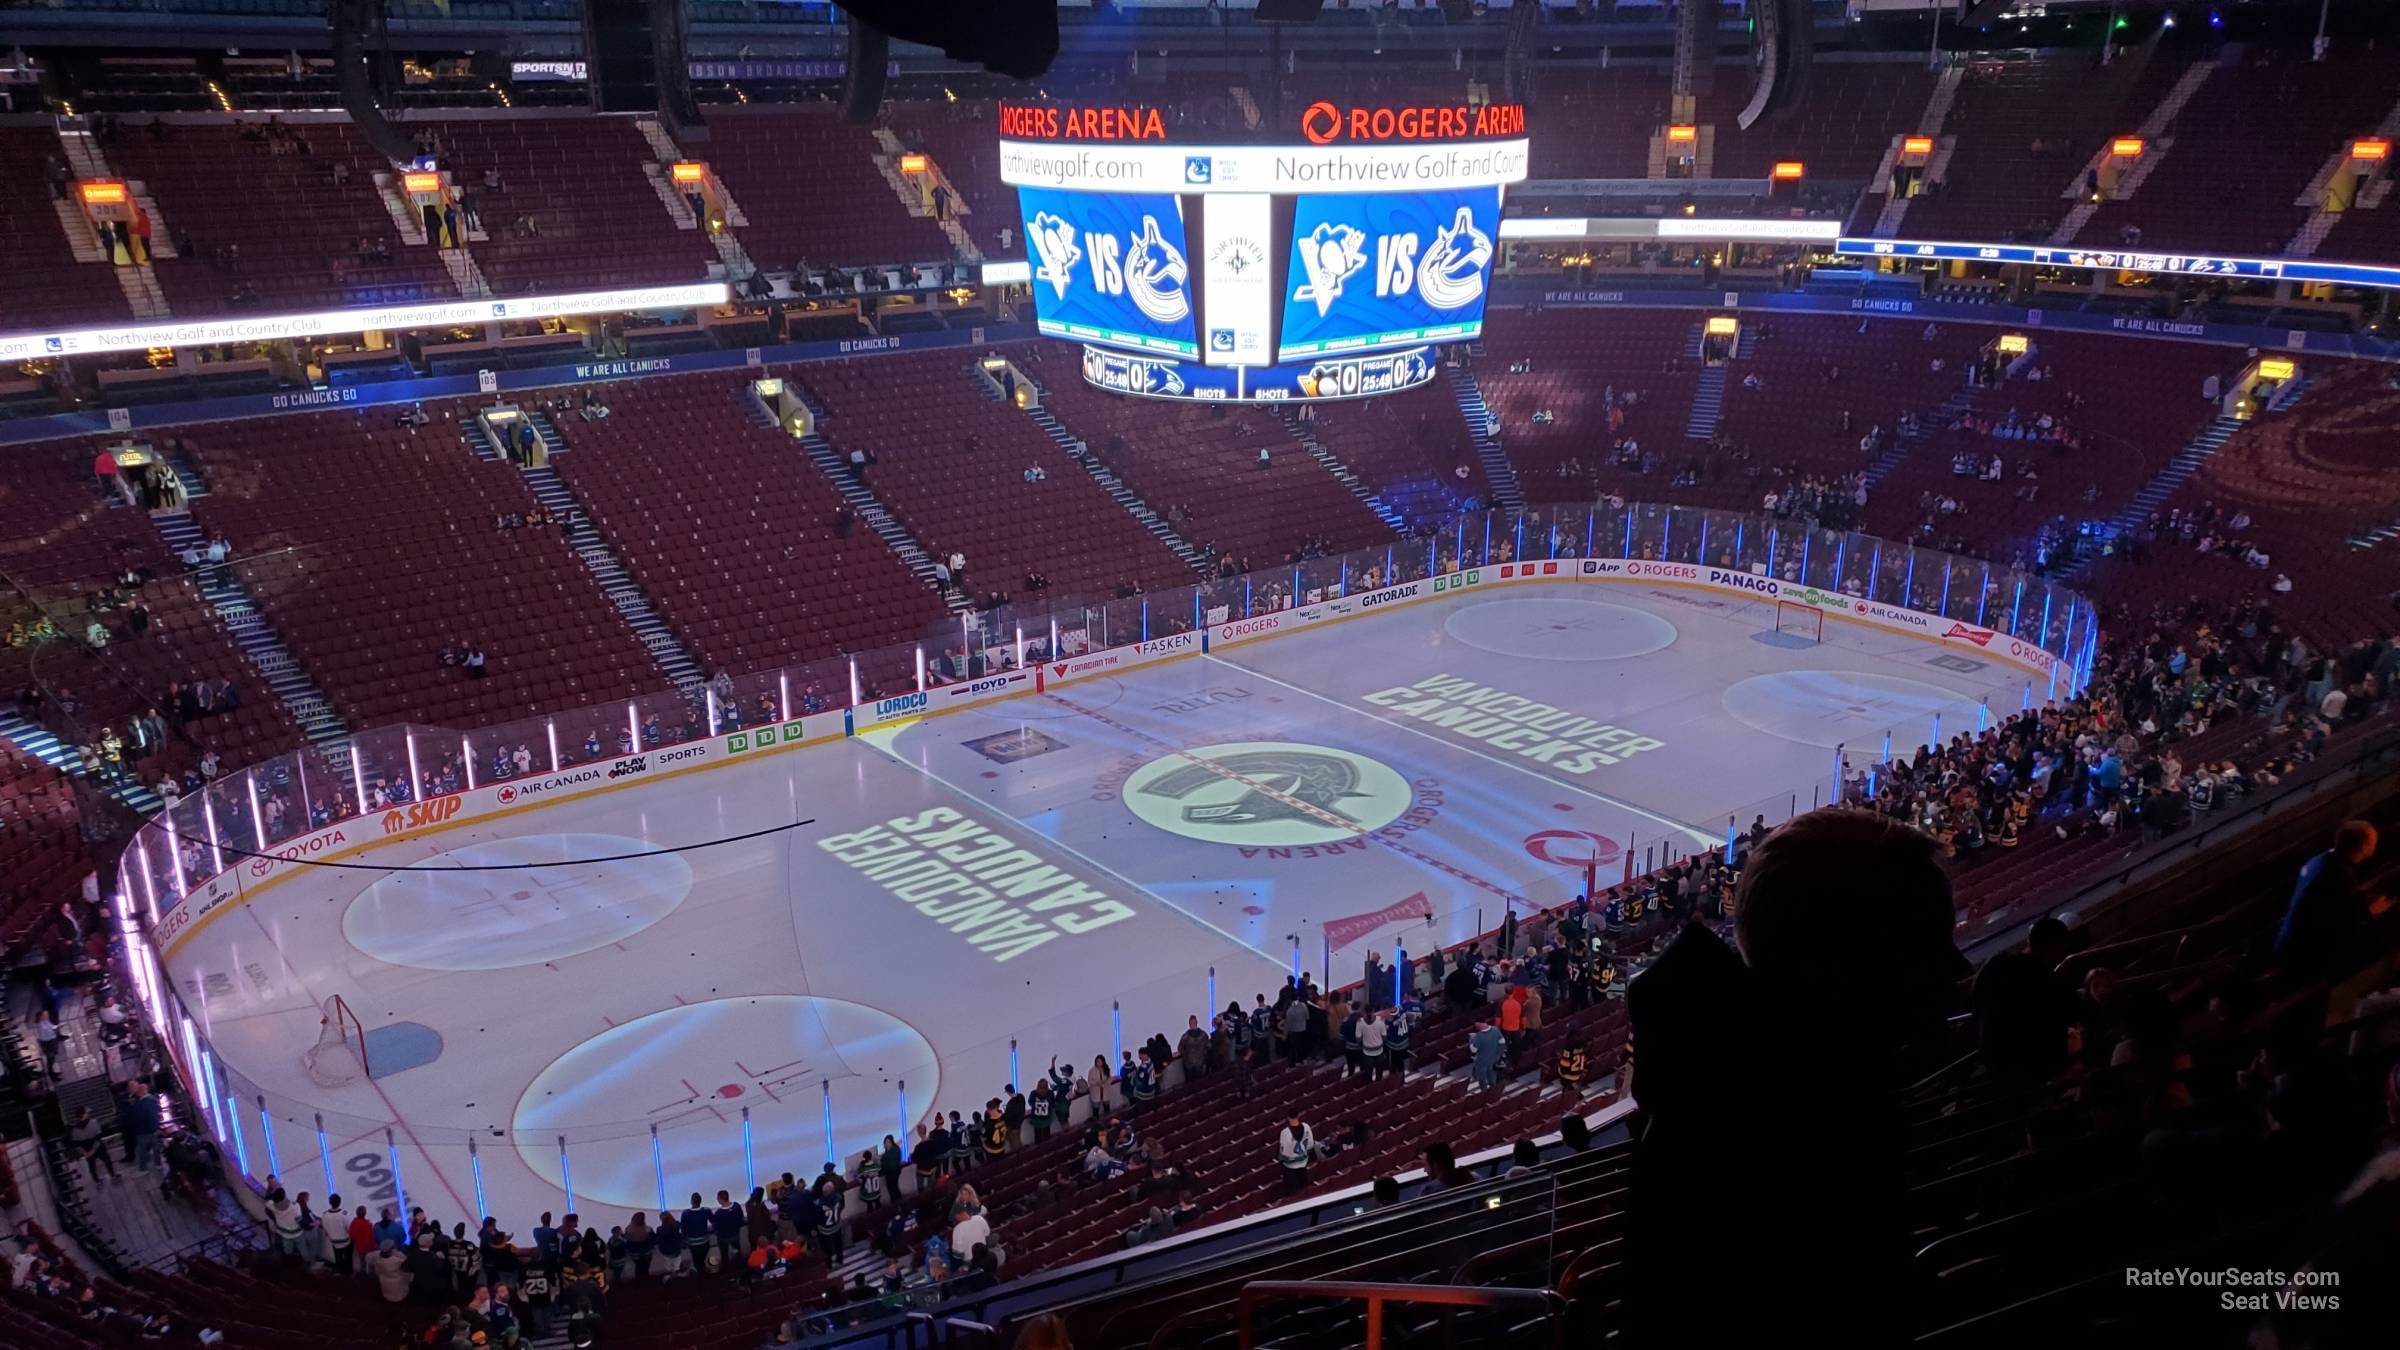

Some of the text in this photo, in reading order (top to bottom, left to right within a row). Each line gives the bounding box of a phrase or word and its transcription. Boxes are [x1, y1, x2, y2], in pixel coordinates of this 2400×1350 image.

[1003, 107, 1166, 139] ROGERS ARENA
[1350, 104, 1524, 139] ROGERS ARENA
[1275, 154, 1410, 181] Northview
[1415, 152, 1459, 179] Golf
[1461, 150, 1491, 177] and
[1084, 231, 1125, 296] VS
[1376, 233, 1417, 297] VS
[1545, 292, 1624, 302] WE ARE ALL CANUCKS
[1852, 298, 1913, 312] GO CANUCKS GO
[362, 307, 477, 325] northviewgolf.com
[98, 330, 173, 346] Northview
[176, 326, 206, 342] Golf
[209, 325, 234, 338] and
[237, 321, 288, 337] Country
[292, 318, 321, 331] Club
[2113, 318, 2204, 335] WE ARE ALL CANUCKS
[840, 337, 900, 352] GO CANUCKS GO
[576, 359, 671, 378] WE ARE ALL CANUCKS
[1095, 356, 1102, 381] 0
[1363, 359, 1391, 371] PREGAME
[1393, 359, 1404, 386] 0
[481, 375, 496, 386] 105
[1131, 363, 1143, 389] 0
[1342, 366, 1357, 393] 0
[273, 389, 357, 408] GO CANUCKS GO
[1194, 389, 1226, 399] SHOTS
[1256, 389, 1288, 399] SHOTS
[110, 411, 128, 422] 104
[1644, 564, 1697, 579] ROGERS
[1710, 570, 1778, 595] PANAGO
[1362, 584, 1418, 607] GATORADE
[1870, 606, 1928, 626] AIR CANADA
[1236, 617, 1279, 636] ROGERS
[1143, 634, 1192, 655] FASKEN
[1071, 656, 1119, 673] CANADIAN TIRE
[972, 678, 1006, 693] BOYD
[876, 692, 928, 715] LORDCO
[885, 708, 919, 721] AUTO PARTS
[1411, 673, 1666, 759] VANCOUVER
[1362, 686, 1620, 775] CANUCKS
[615, 757, 646, 769] PLAY
[659, 746, 706, 764] SPORTS
[616, 763, 647, 777] NOW
[520, 769, 600, 796] AIR CANADA
[406, 795, 462, 829] SKIP
[276, 831, 346, 865] TOYOTA
[1237, 838, 1368, 860] ARENA
[888, 806, 1137, 935] CANUCKS
[816, 825, 1061, 963] VANCOUVER
[525, 1277, 548, 1294] 29
